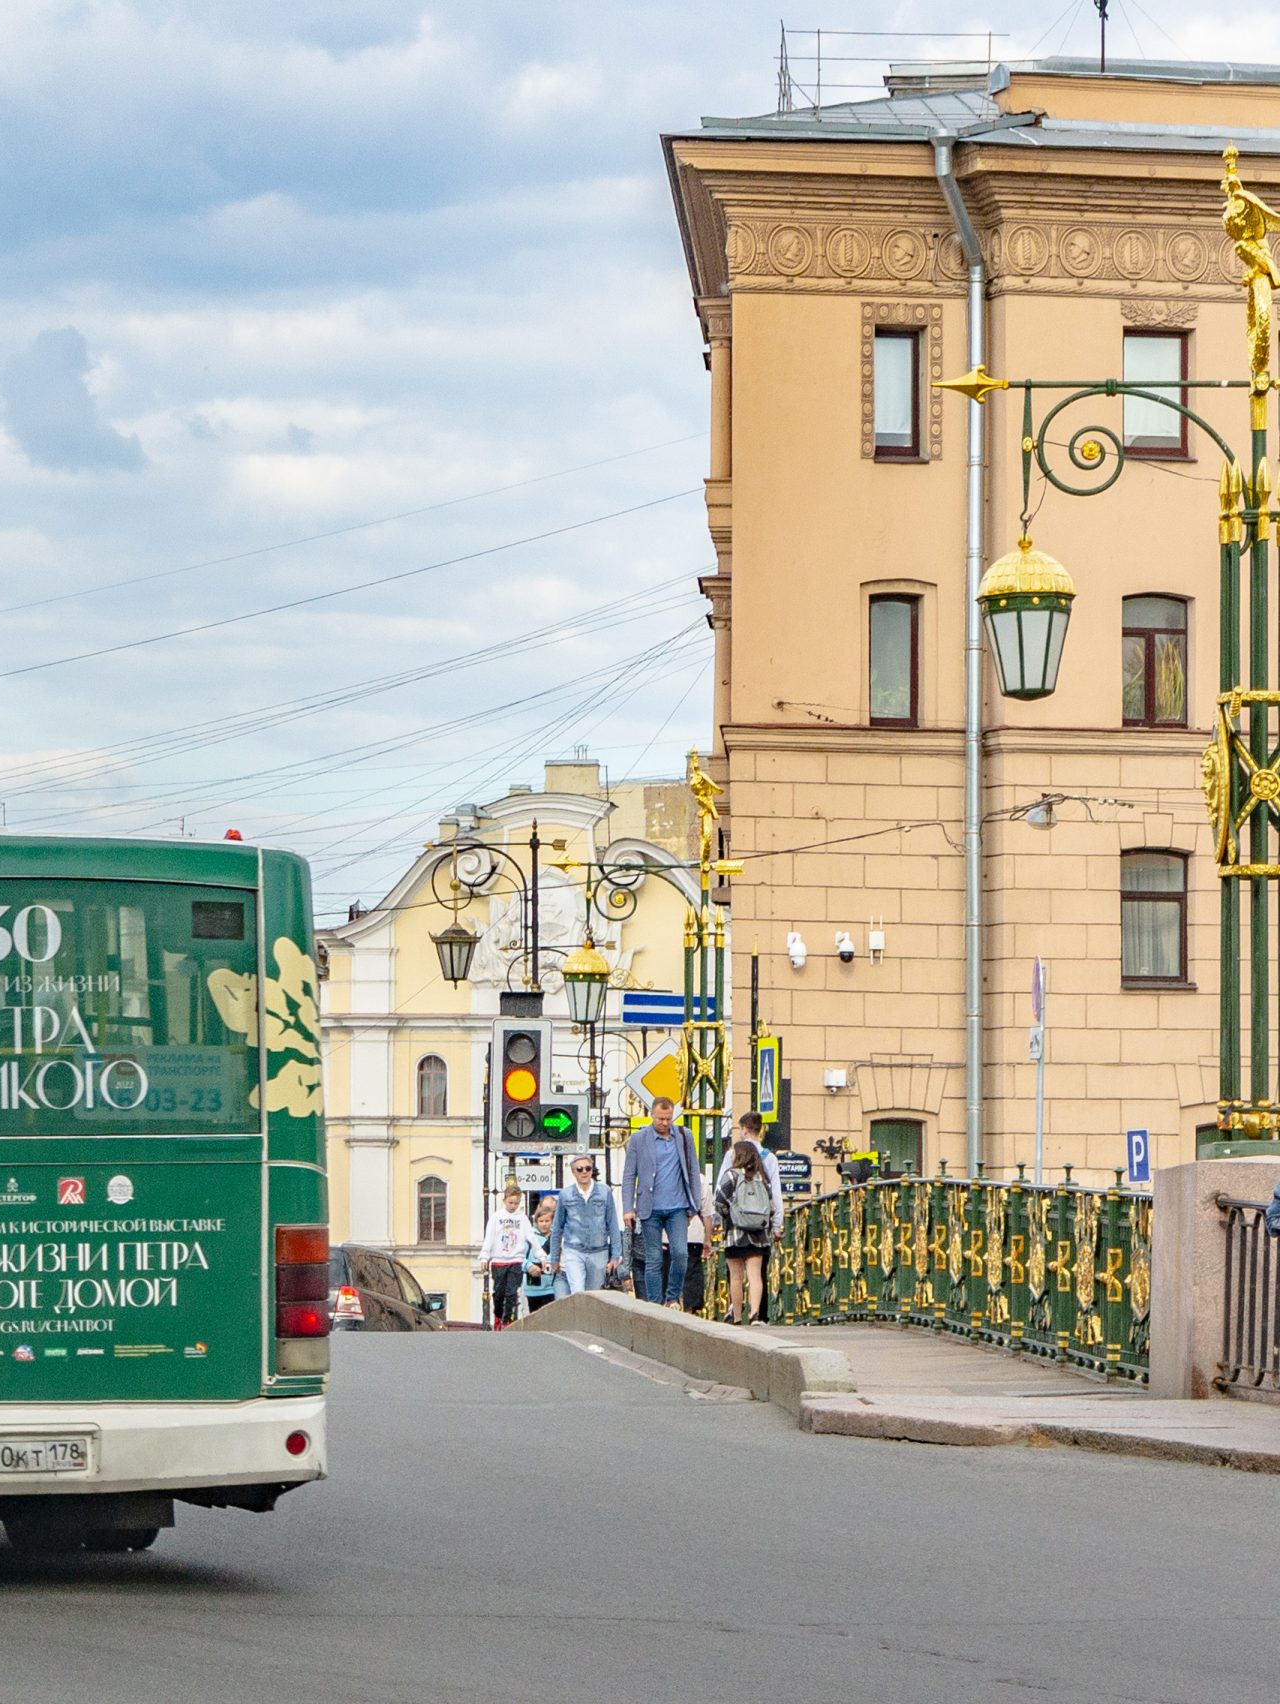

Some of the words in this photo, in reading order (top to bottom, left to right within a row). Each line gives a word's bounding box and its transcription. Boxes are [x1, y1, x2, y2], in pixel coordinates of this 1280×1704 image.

[5, 975, 32, 993] ИЗ
[37, 974, 120, 993] ЖИЗНИ
[1132, 1135, 1145, 1177] P
[777, 1164, 808, 1172] ОНТАНКИ
[785, 1183, 795, 1191] 12
[9, 1221, 19, 1234] К
[21, 1218, 147, 1234] ИСТОРИЧЕСКОЙ
[149, 1218, 226, 1232] ВЫСТАВКЕ
[118, 1241, 209, 1270] ПЕТРА
[53, 1277, 177, 1314] ДОМОЙ
[49, 1443, 81, 1461] 178
